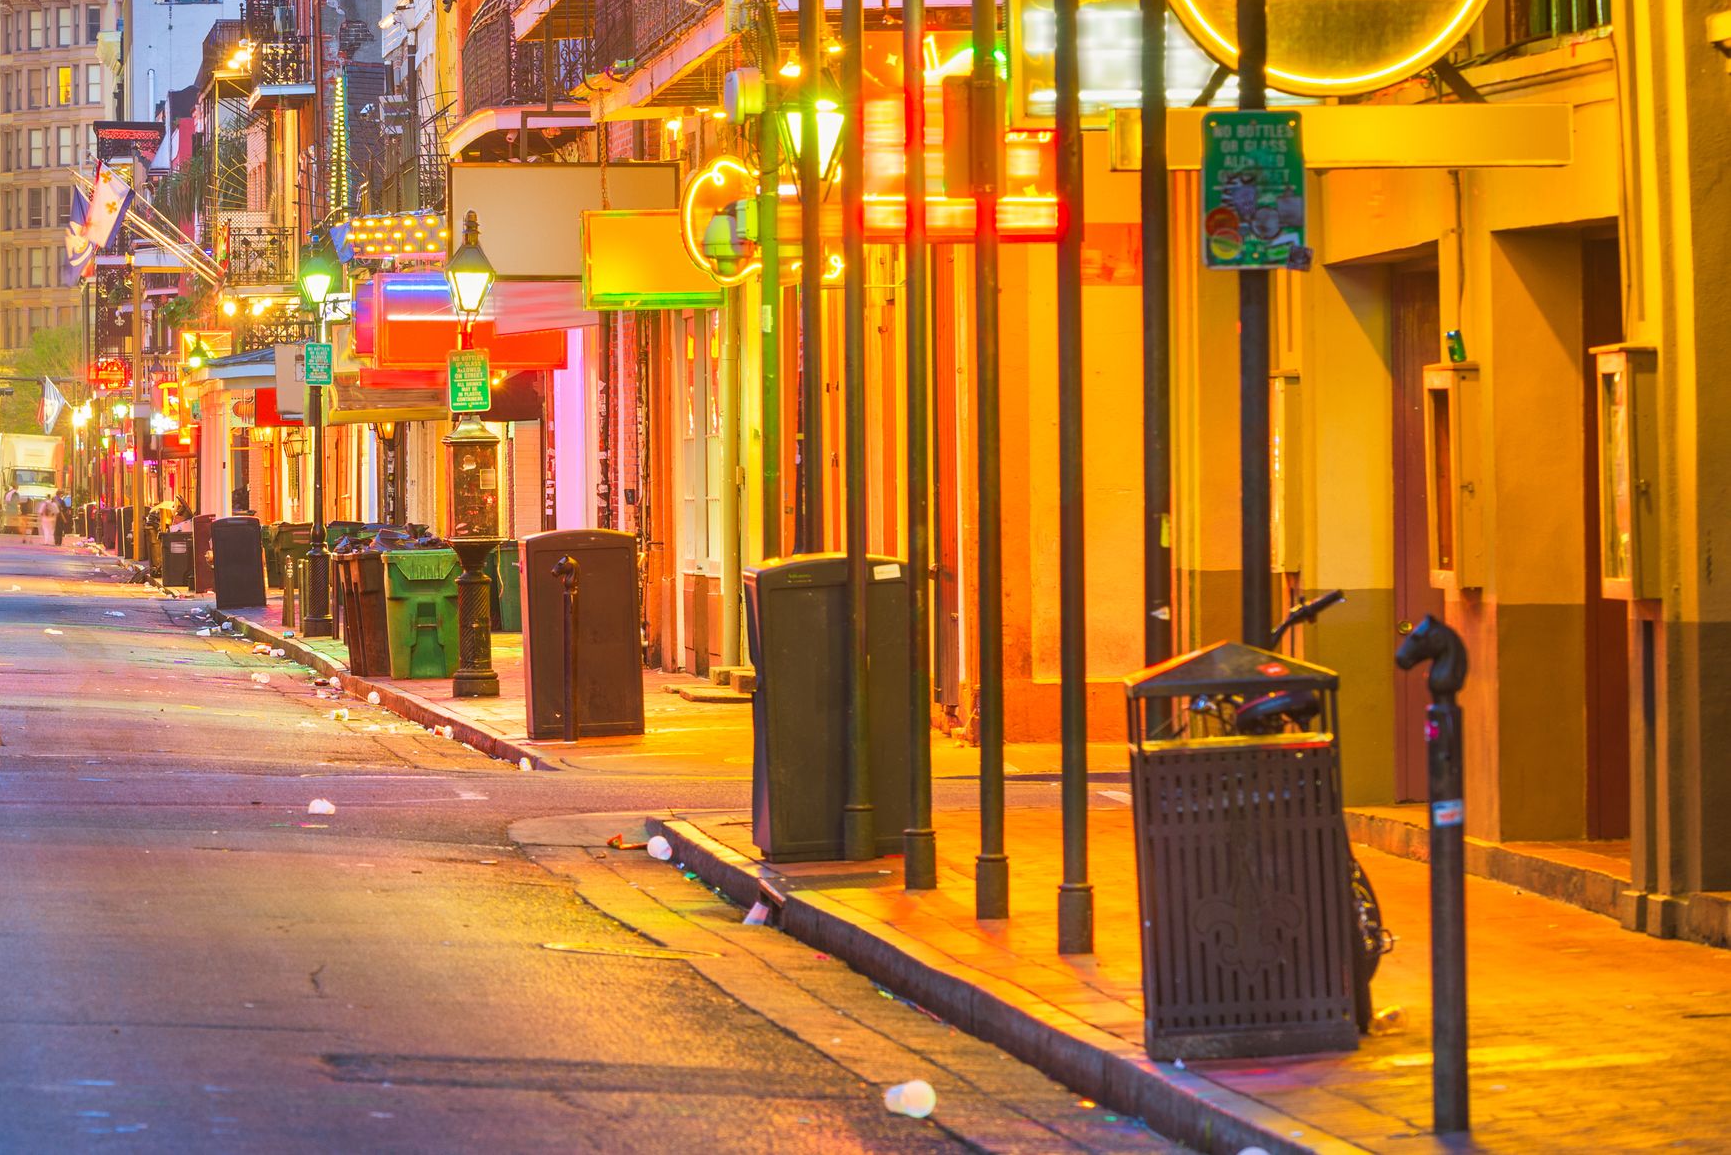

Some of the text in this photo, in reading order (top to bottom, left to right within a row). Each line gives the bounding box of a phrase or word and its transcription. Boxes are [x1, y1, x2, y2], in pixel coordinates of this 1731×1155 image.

[1213, 124, 1294, 138] NO BOTTLES
[1220, 140, 1239, 153] OR
